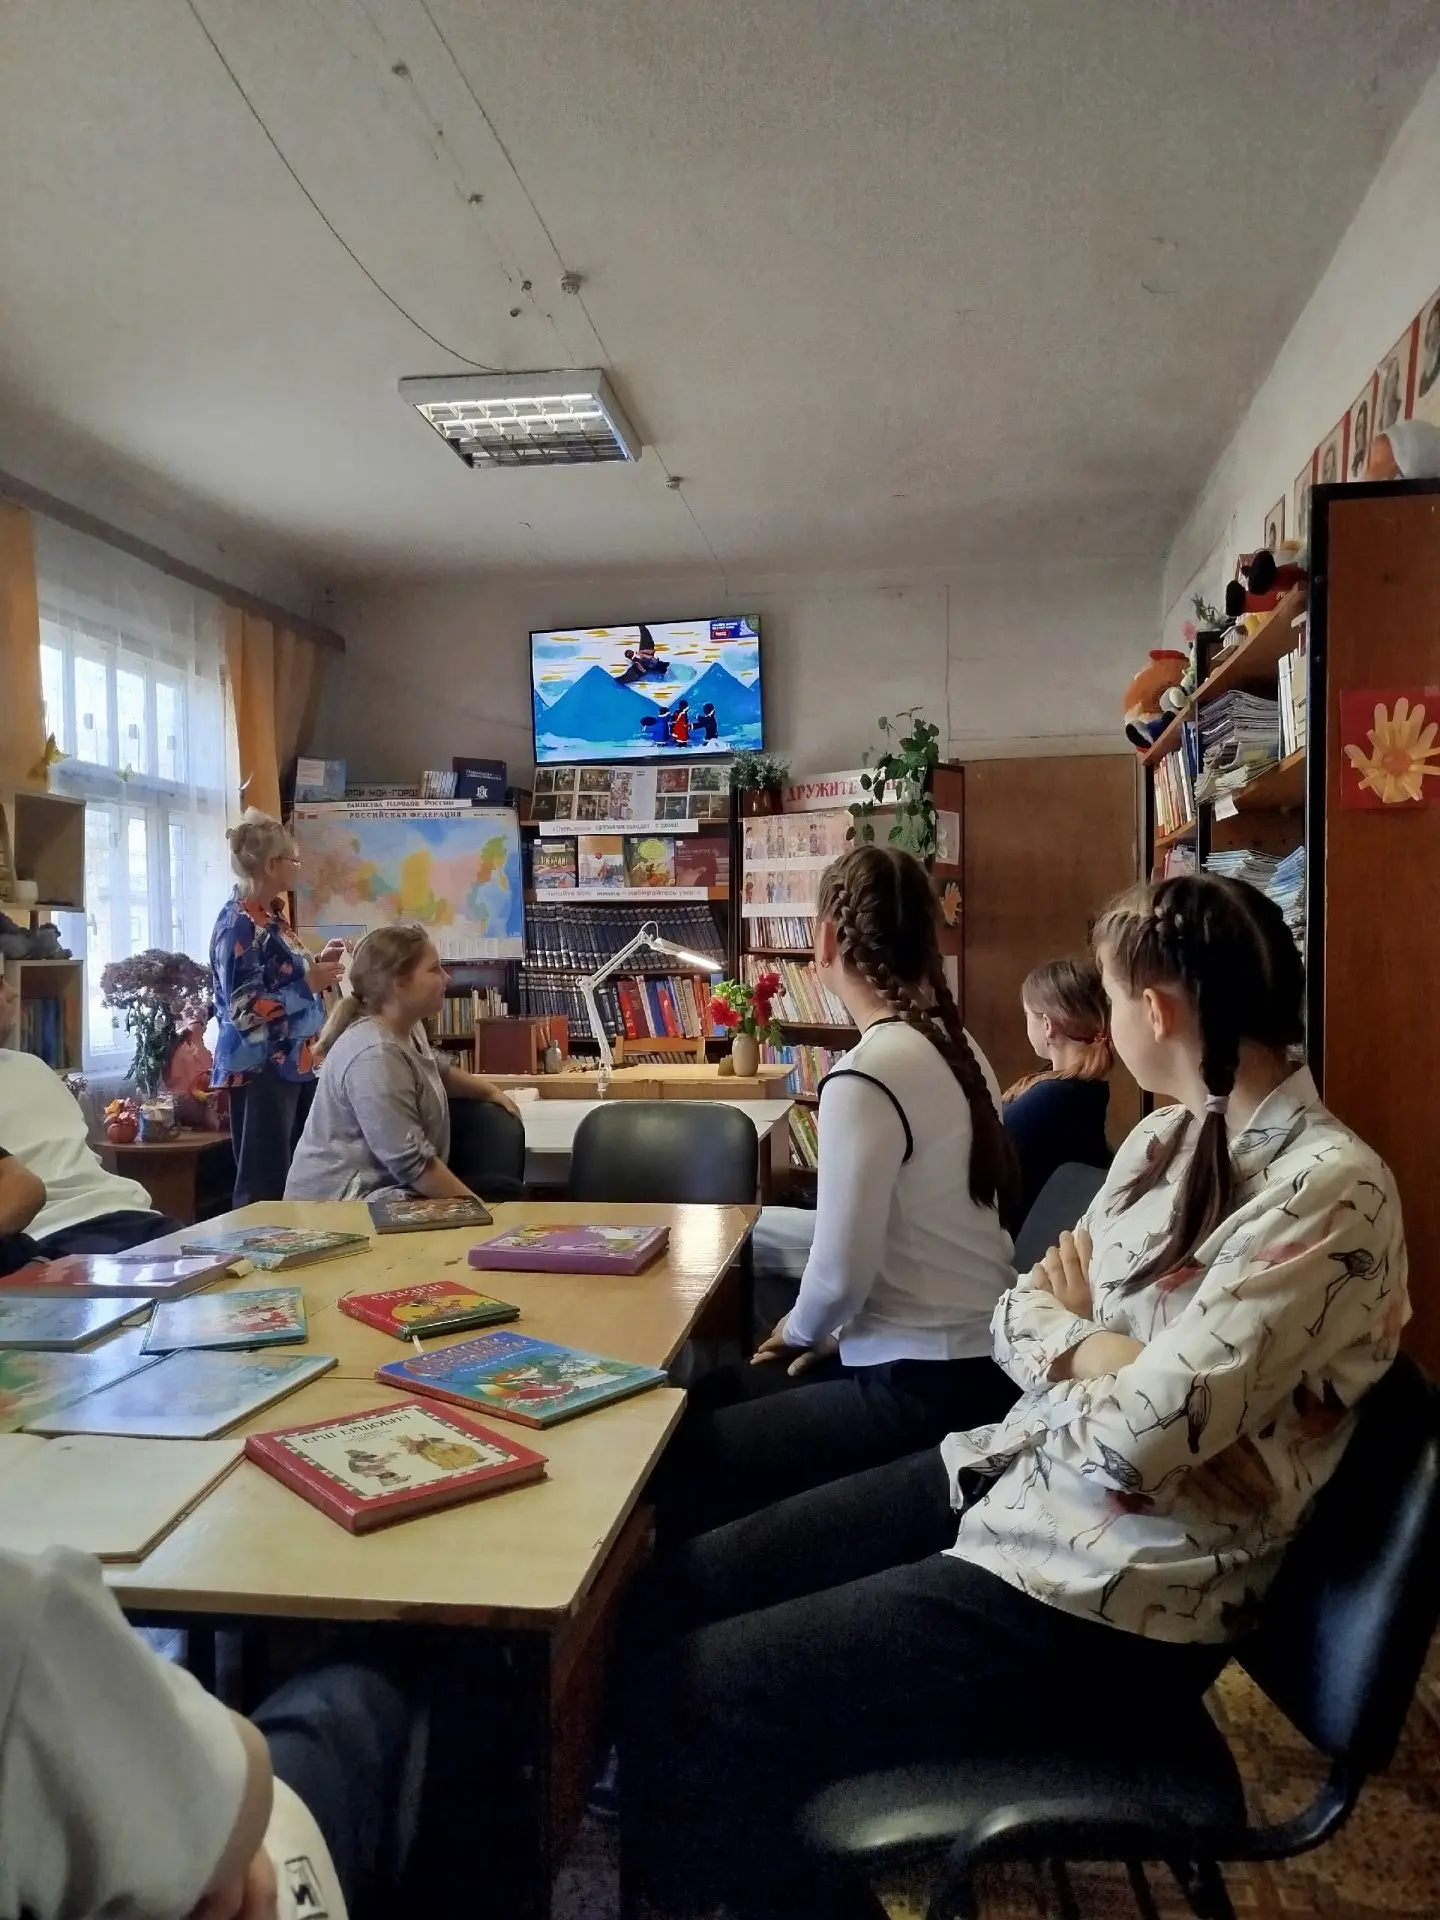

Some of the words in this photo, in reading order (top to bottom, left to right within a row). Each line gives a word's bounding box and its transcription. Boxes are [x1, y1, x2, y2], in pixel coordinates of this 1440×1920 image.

[787, 781, 858, 802] ДРУЖИТЬ
[349, 811, 407, 819] РОССИЙСКАЯ
[409, 811, 461, 819] ФЕДЕРАЦИЯ
[370, 1284, 444, 1302] СКАЗКИ
